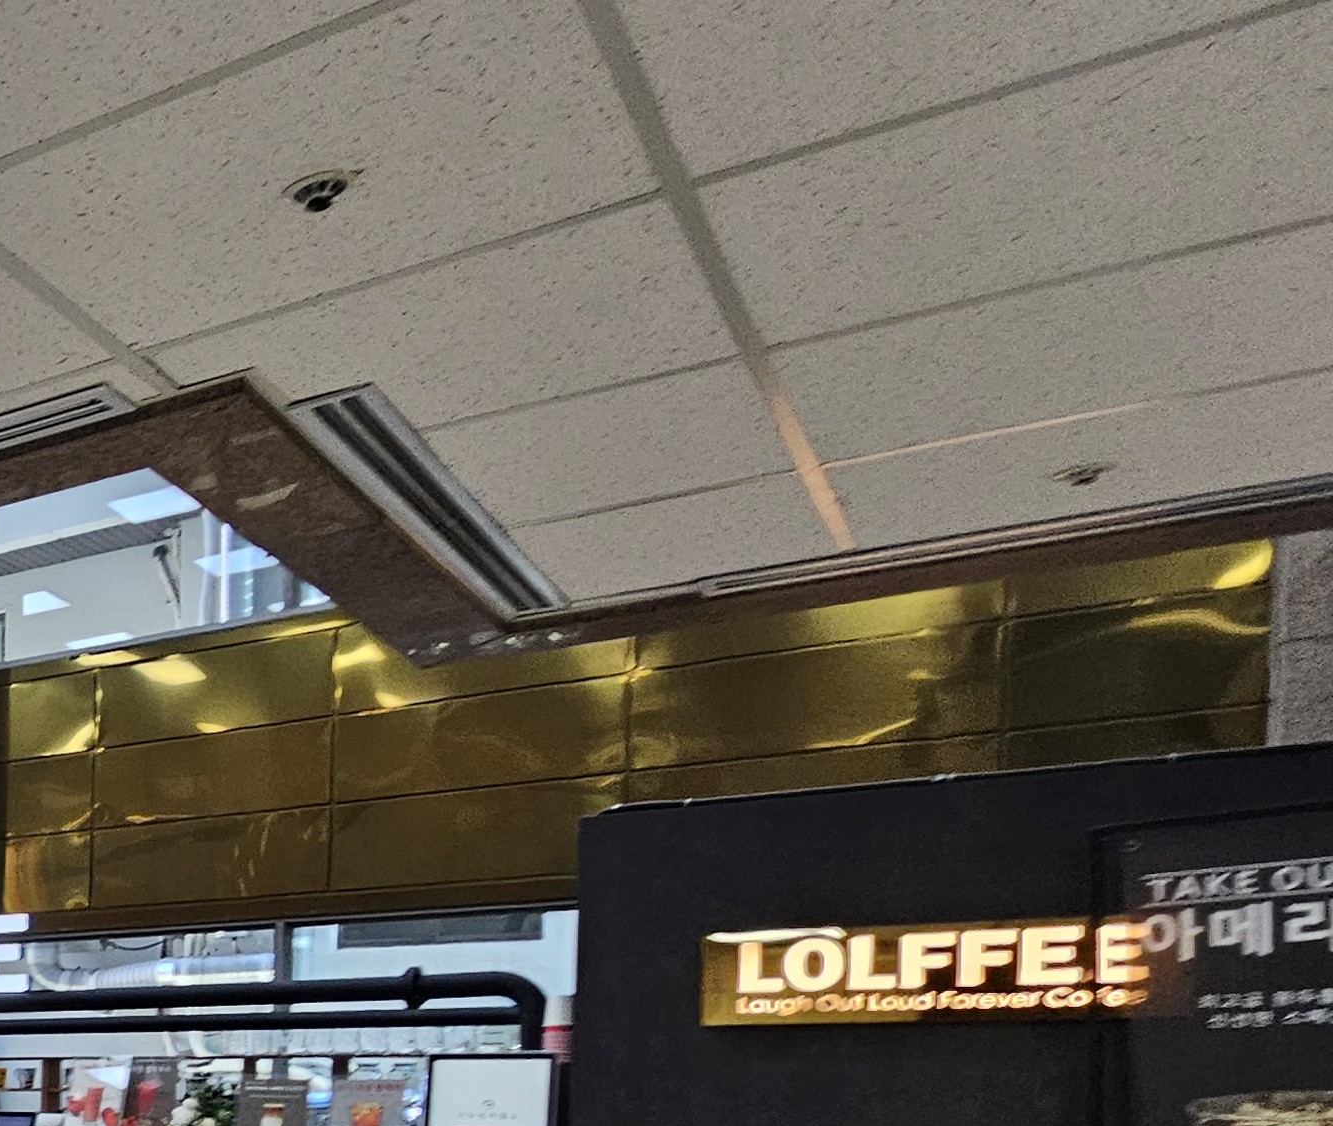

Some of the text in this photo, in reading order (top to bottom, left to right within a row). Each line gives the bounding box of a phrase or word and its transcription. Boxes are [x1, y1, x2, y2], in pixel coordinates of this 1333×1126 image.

[1145, 868, 1260, 902] TAKE
[737, 922, 1151, 994] LOLFFEE
[866, 991, 937, 1012] Loud
[937, 990, 1044, 1010] Forever
[1042, 986, 1149, 1009] Cofee
